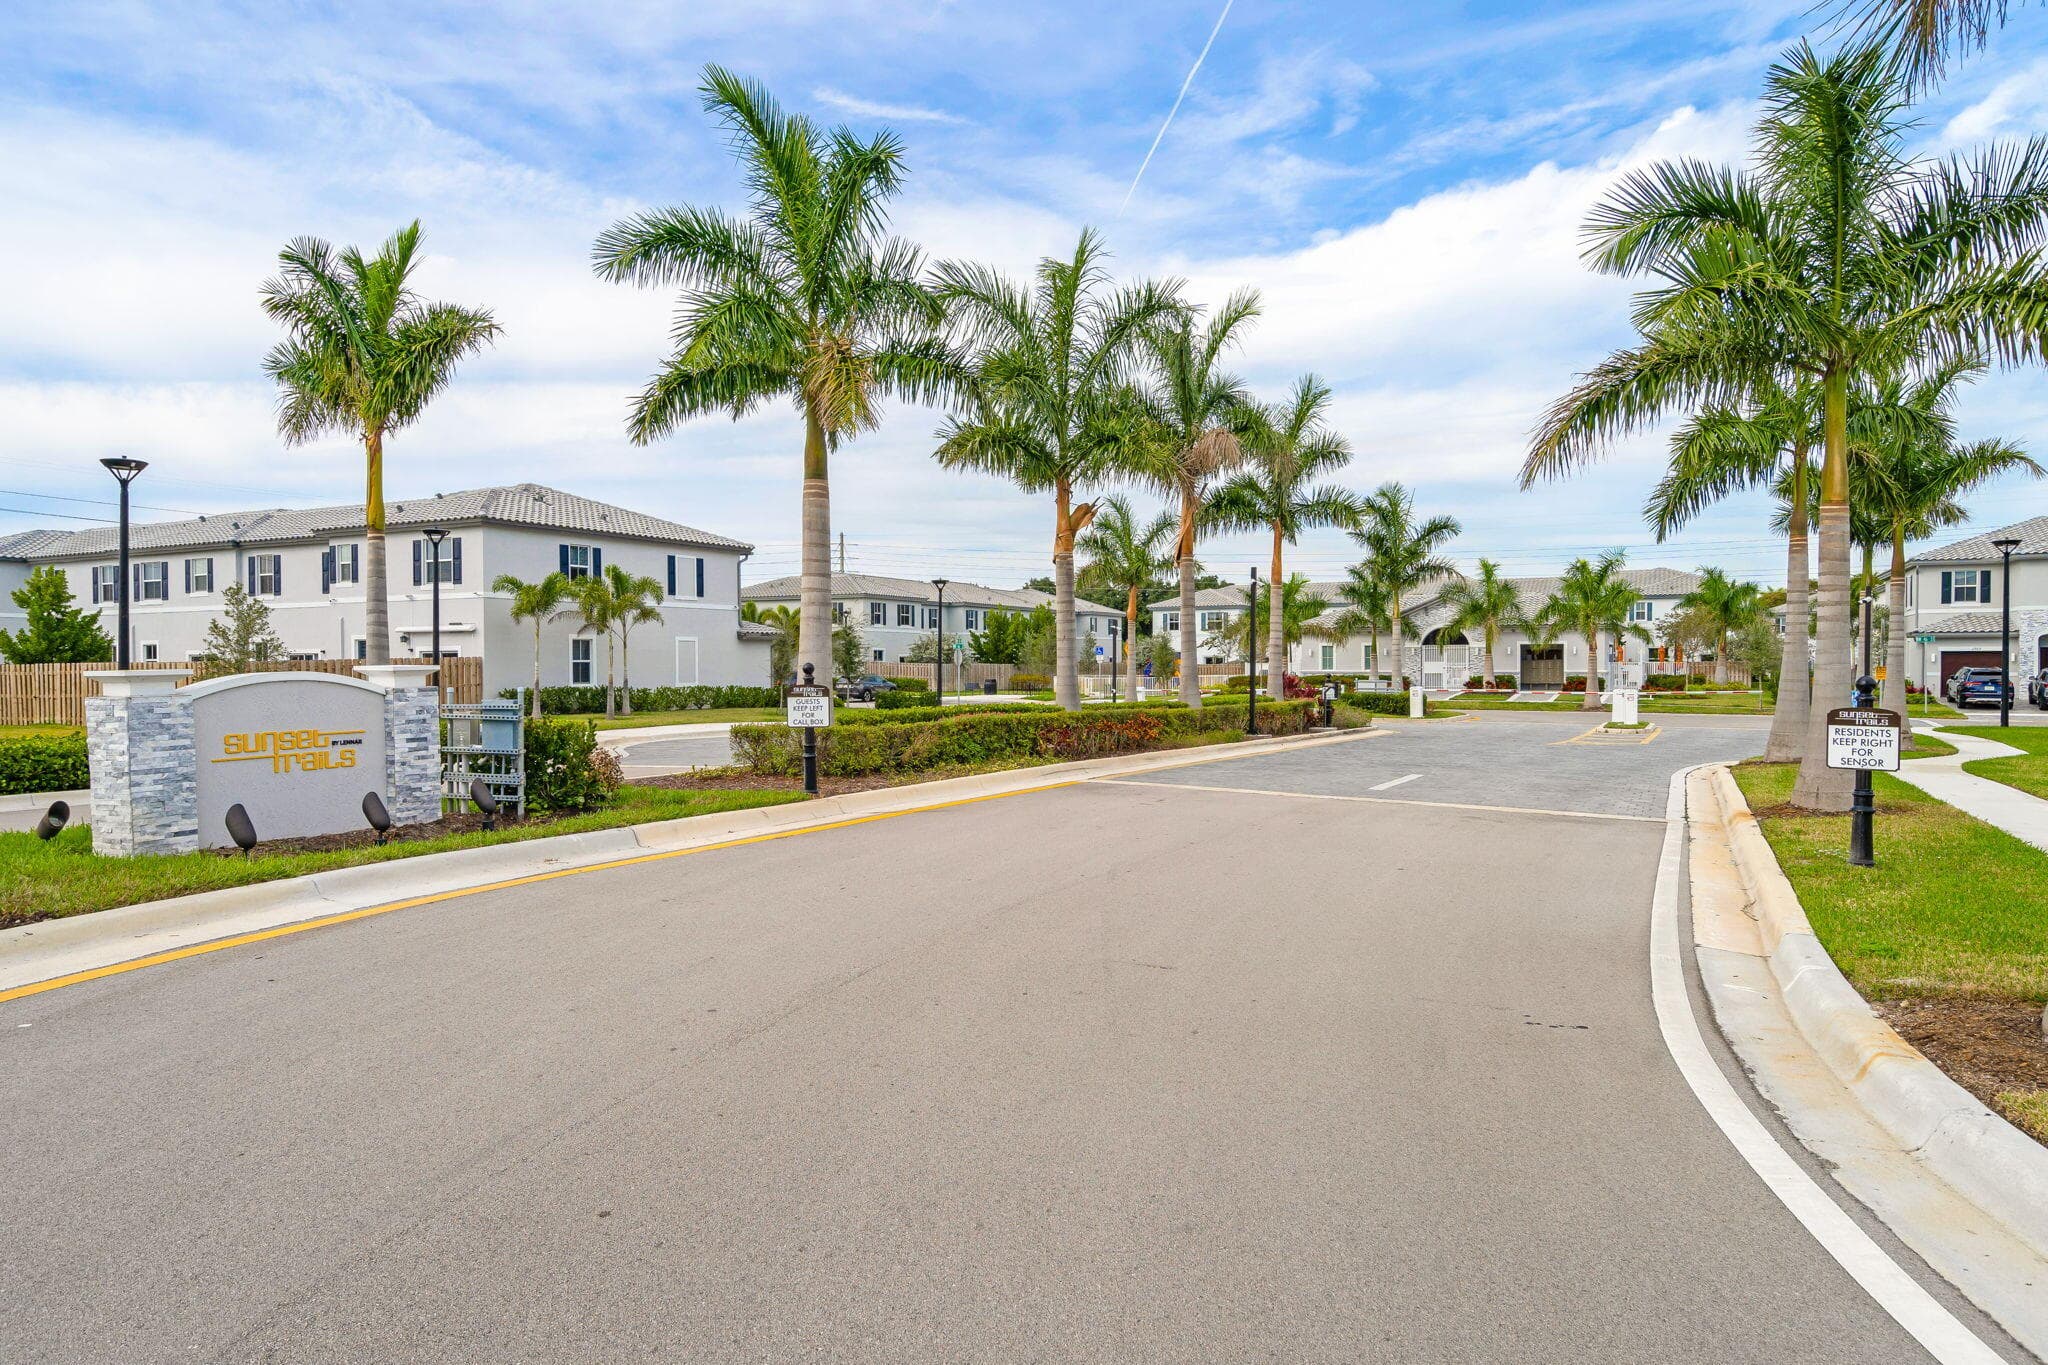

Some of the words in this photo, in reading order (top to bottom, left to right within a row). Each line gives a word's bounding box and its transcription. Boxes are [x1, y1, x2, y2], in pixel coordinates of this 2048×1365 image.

[1834, 728, 1892, 738] RESIDENTS
[1832, 738, 1857, 746] KEEP
[1860, 739, 1894, 748] RIGHT
[1851, 748, 1874, 757] FOR
[1840, 757, 1885, 768] SENSOR
